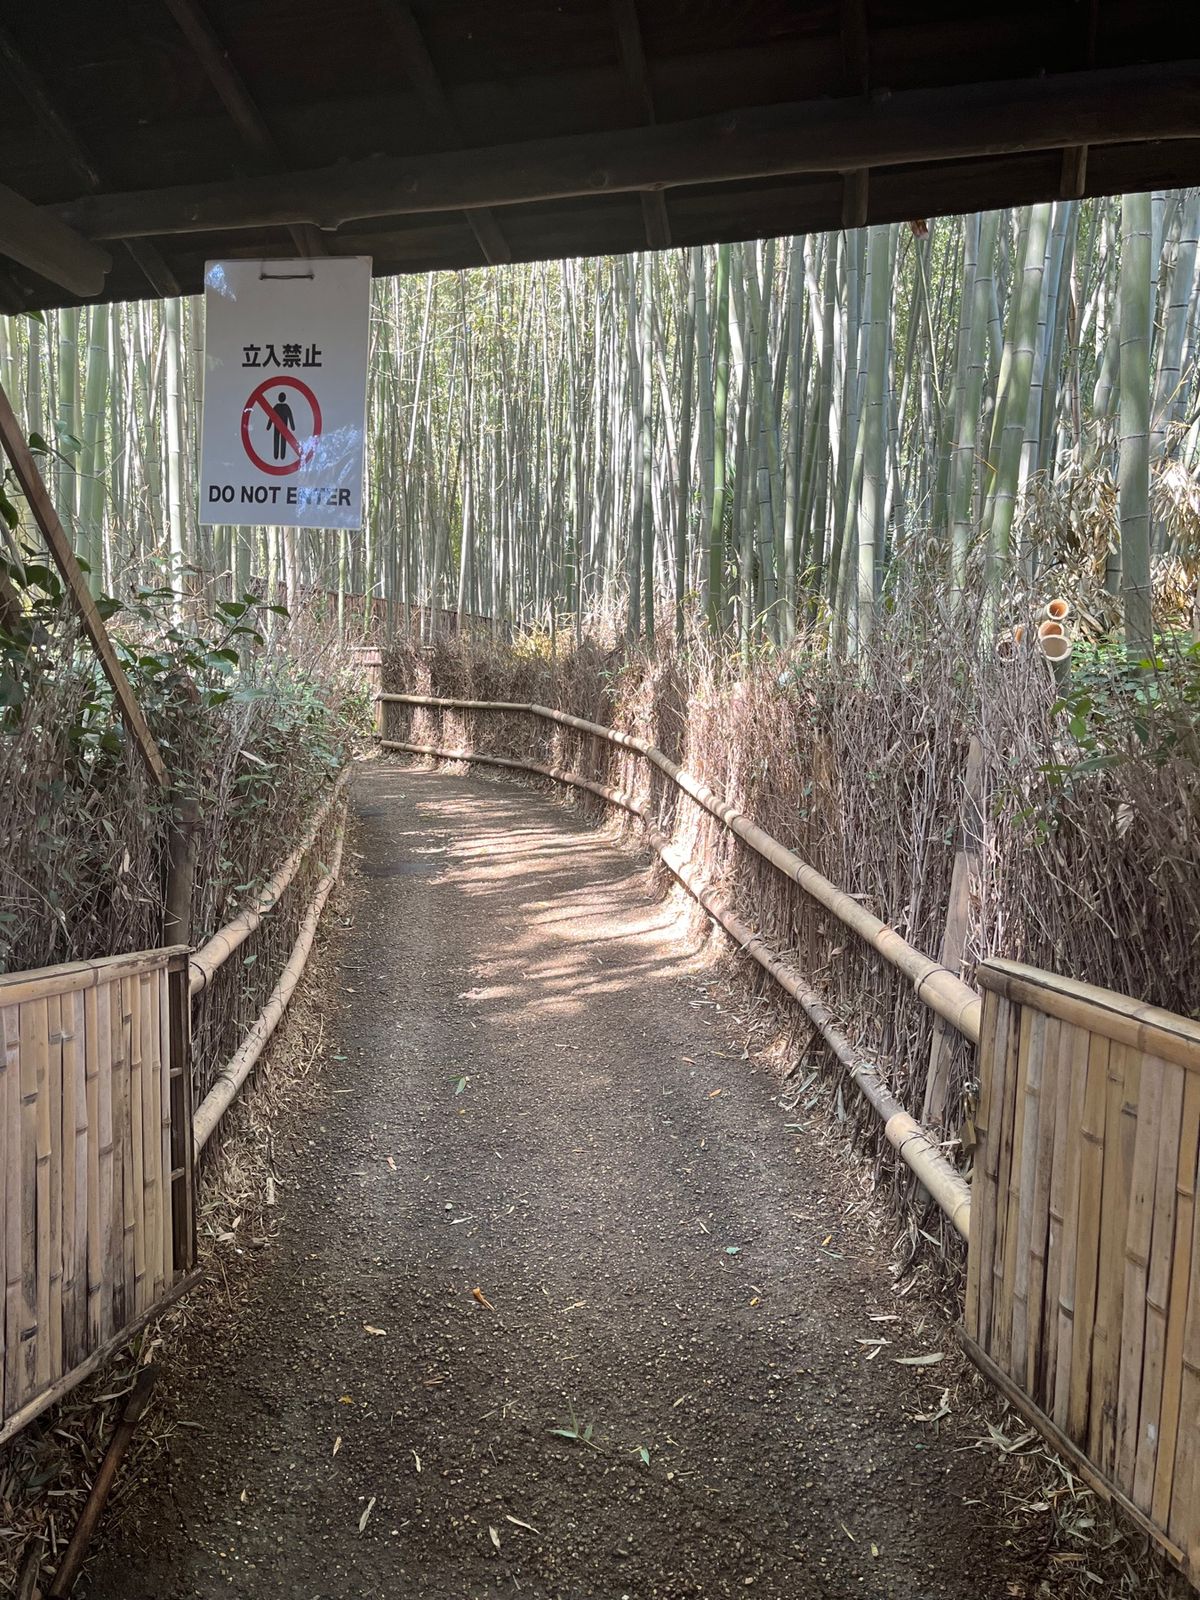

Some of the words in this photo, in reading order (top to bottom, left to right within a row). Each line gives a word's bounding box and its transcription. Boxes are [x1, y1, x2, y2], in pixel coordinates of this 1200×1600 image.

[242, 344, 322, 368] 立入禁止
[209, 485, 235, 503] DO
[241, 486, 281, 504] NOT
